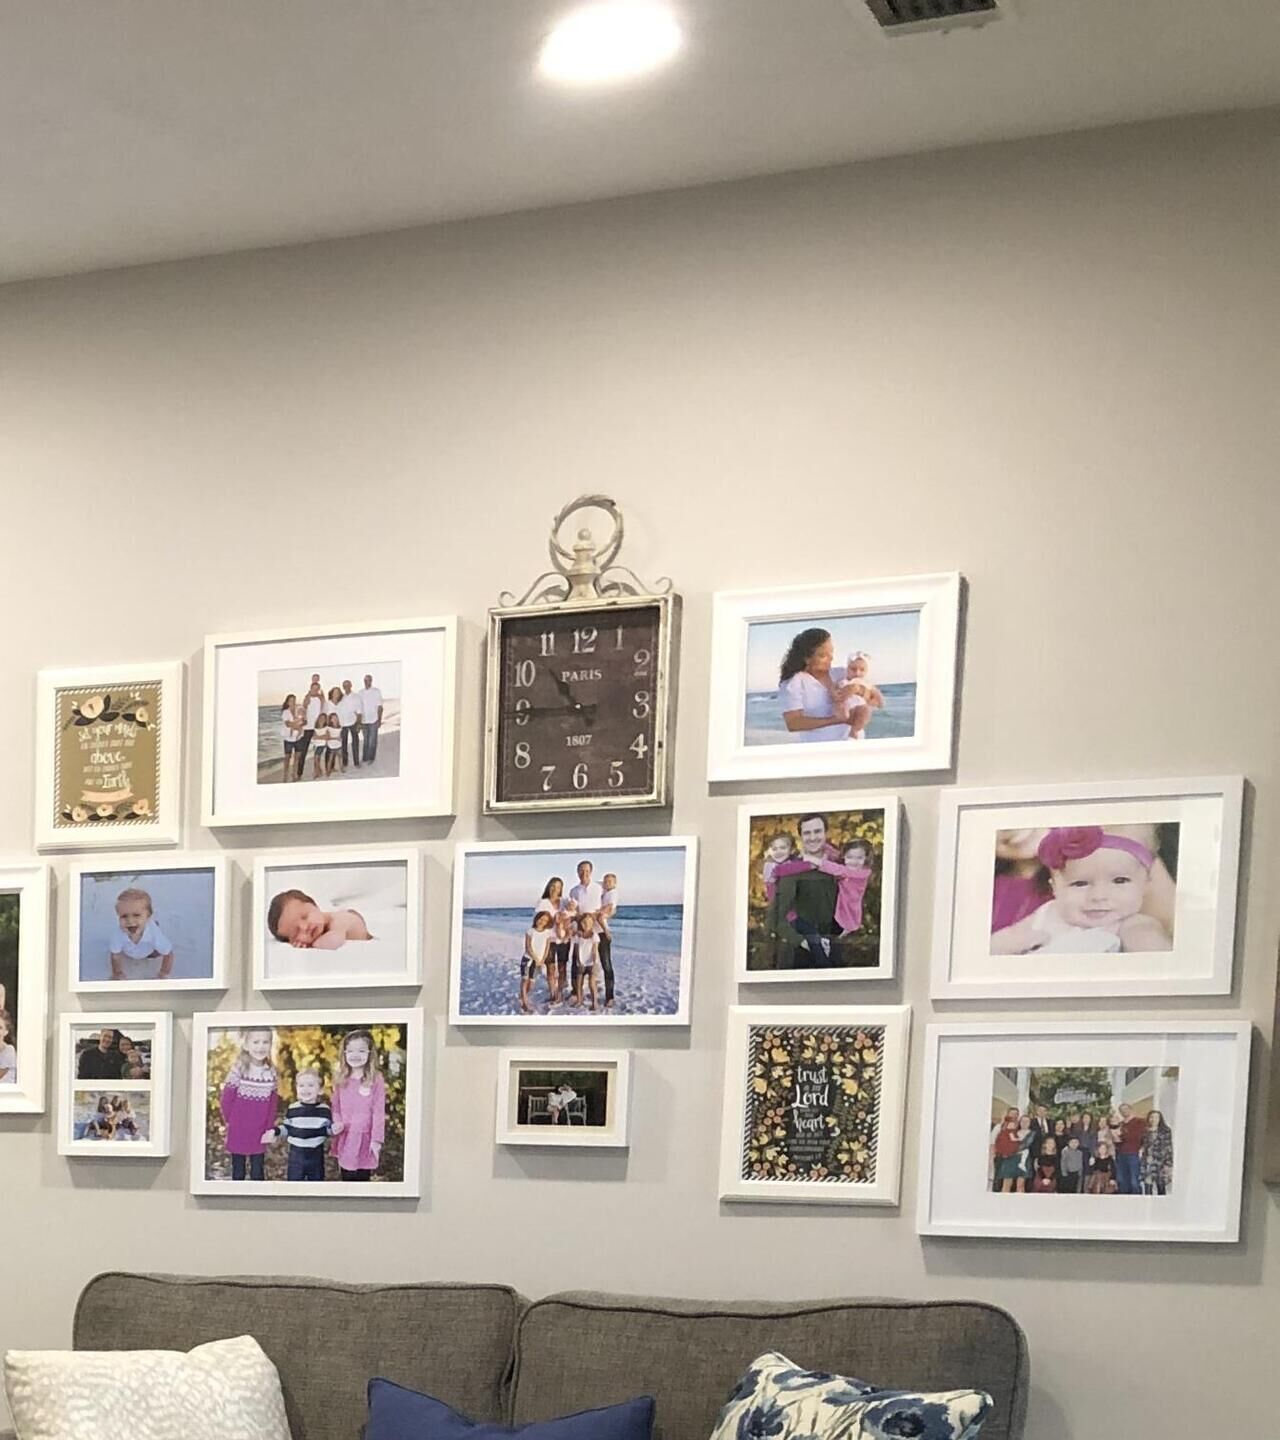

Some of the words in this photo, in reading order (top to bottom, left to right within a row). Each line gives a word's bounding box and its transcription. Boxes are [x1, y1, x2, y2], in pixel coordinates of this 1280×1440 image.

[539, 632, 556, 657] 11
[571, 626, 599, 653] 12
[616, 624, 624, 650] 1
[514, 659, 536, 688] 10
[561, 668, 603, 682] PARIS
[633, 649, 651, 677] 2
[515, 699, 531, 726] 9
[632, 690, 650, 719] 3
[565, 734, 593, 747] 1807
[629, 733, 648, 759] 4
[514, 742, 531, 769] 8
[541, 765, 556, 791] 7
[572, 763, 588, 790] 6
[608, 761, 624, 788] 5
[797, 1066, 828, 1084] trust
[791, 1084, 828, 1108] Lord
[793, 1109, 825, 1132] heart
